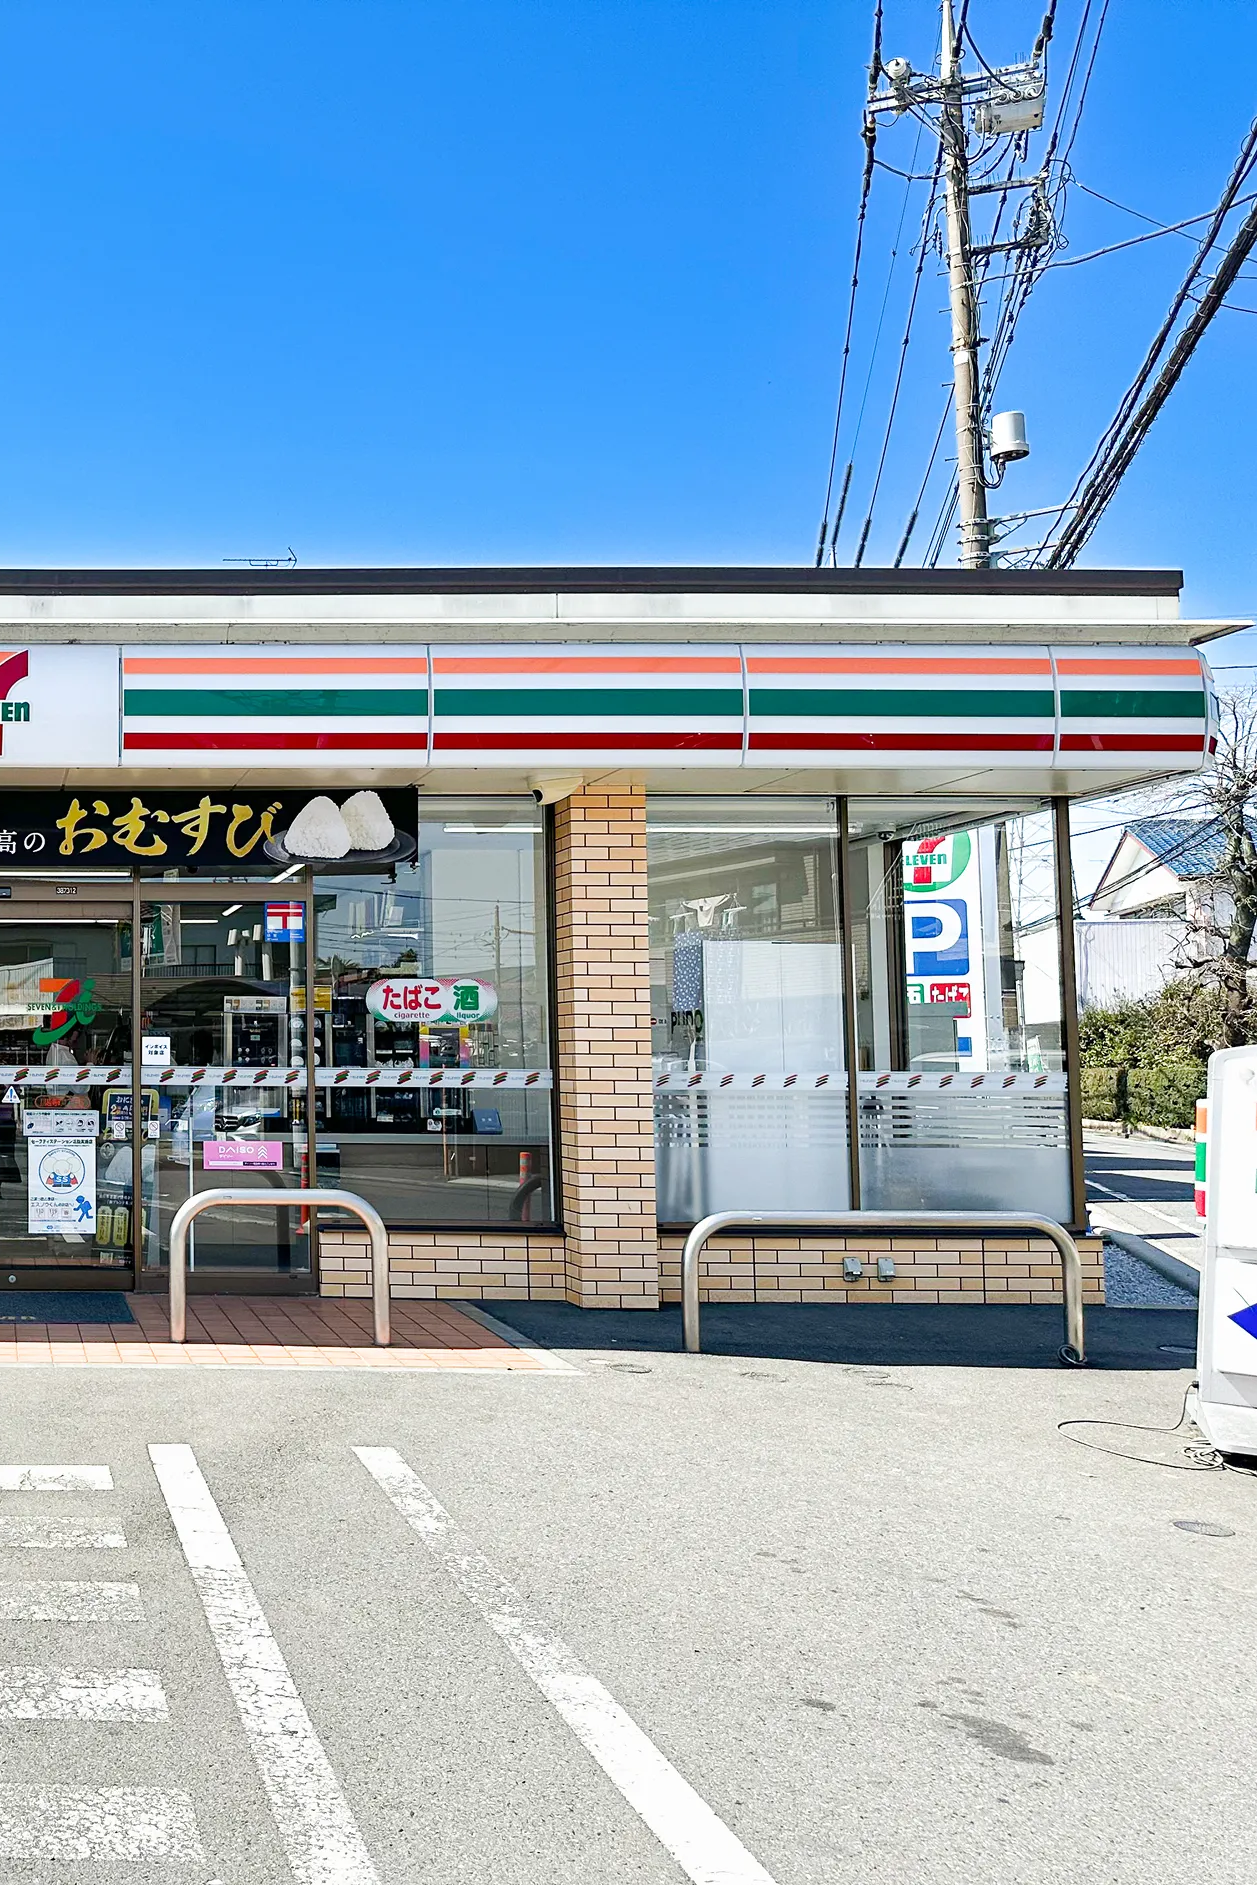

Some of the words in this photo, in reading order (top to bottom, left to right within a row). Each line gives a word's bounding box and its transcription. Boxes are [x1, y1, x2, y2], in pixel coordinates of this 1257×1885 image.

[56, 795, 284, 858] おむすび
[905, 902, 962, 974] P
[383, 984, 441, 1010] たばこ
[453, 985, 479, 1010] 酒
[456, 1011, 480, 1019] liquor
[219, 1146, 254, 1154] DAISO
